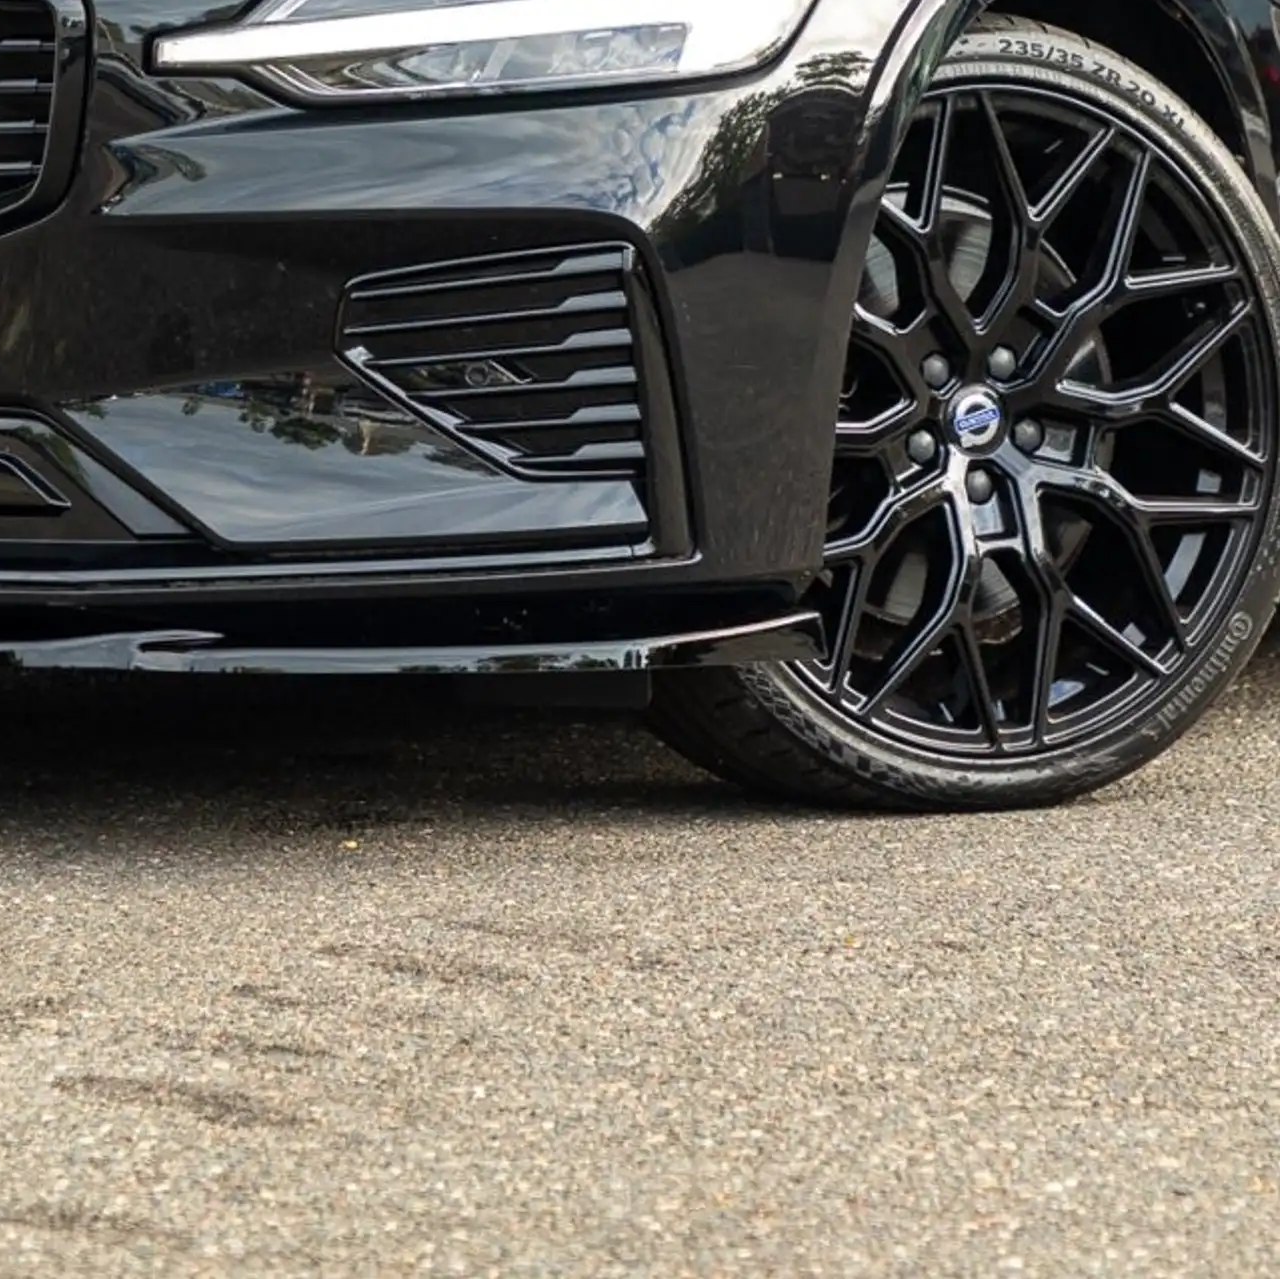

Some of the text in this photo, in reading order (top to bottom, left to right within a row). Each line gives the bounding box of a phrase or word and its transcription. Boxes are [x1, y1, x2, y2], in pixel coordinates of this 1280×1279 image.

[999, 37, 1084, 70] 235/35
[1091, 61, 1122, 87] ZR
[1124, 79, 1157, 108] 20
